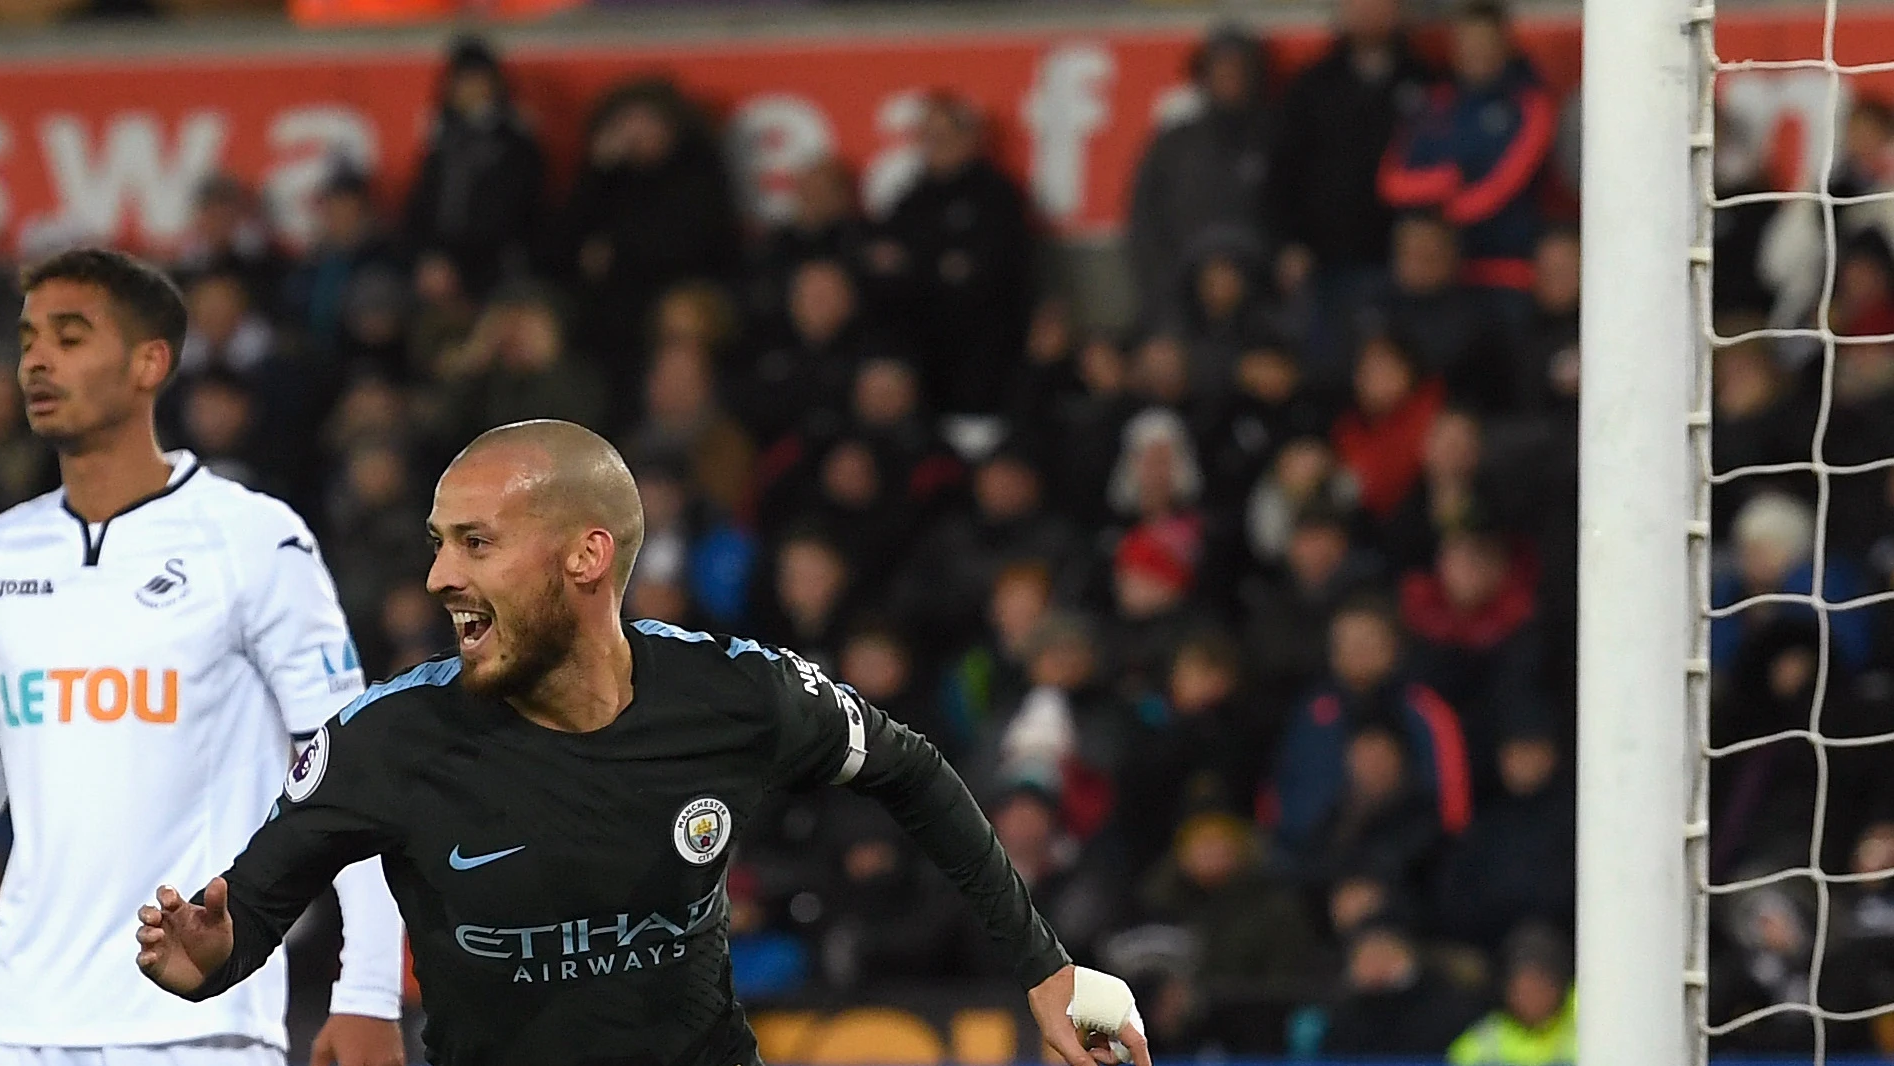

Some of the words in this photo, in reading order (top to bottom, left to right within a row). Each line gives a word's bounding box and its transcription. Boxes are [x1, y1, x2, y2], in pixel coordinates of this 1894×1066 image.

[0, 667, 179, 728] LETOU
[677, 800, 728, 829] MANCHESTER
[697, 851, 716, 863] CITY
[456, 880, 723, 960] ETIHAD
[513, 942, 686, 983] AIRWAYS
